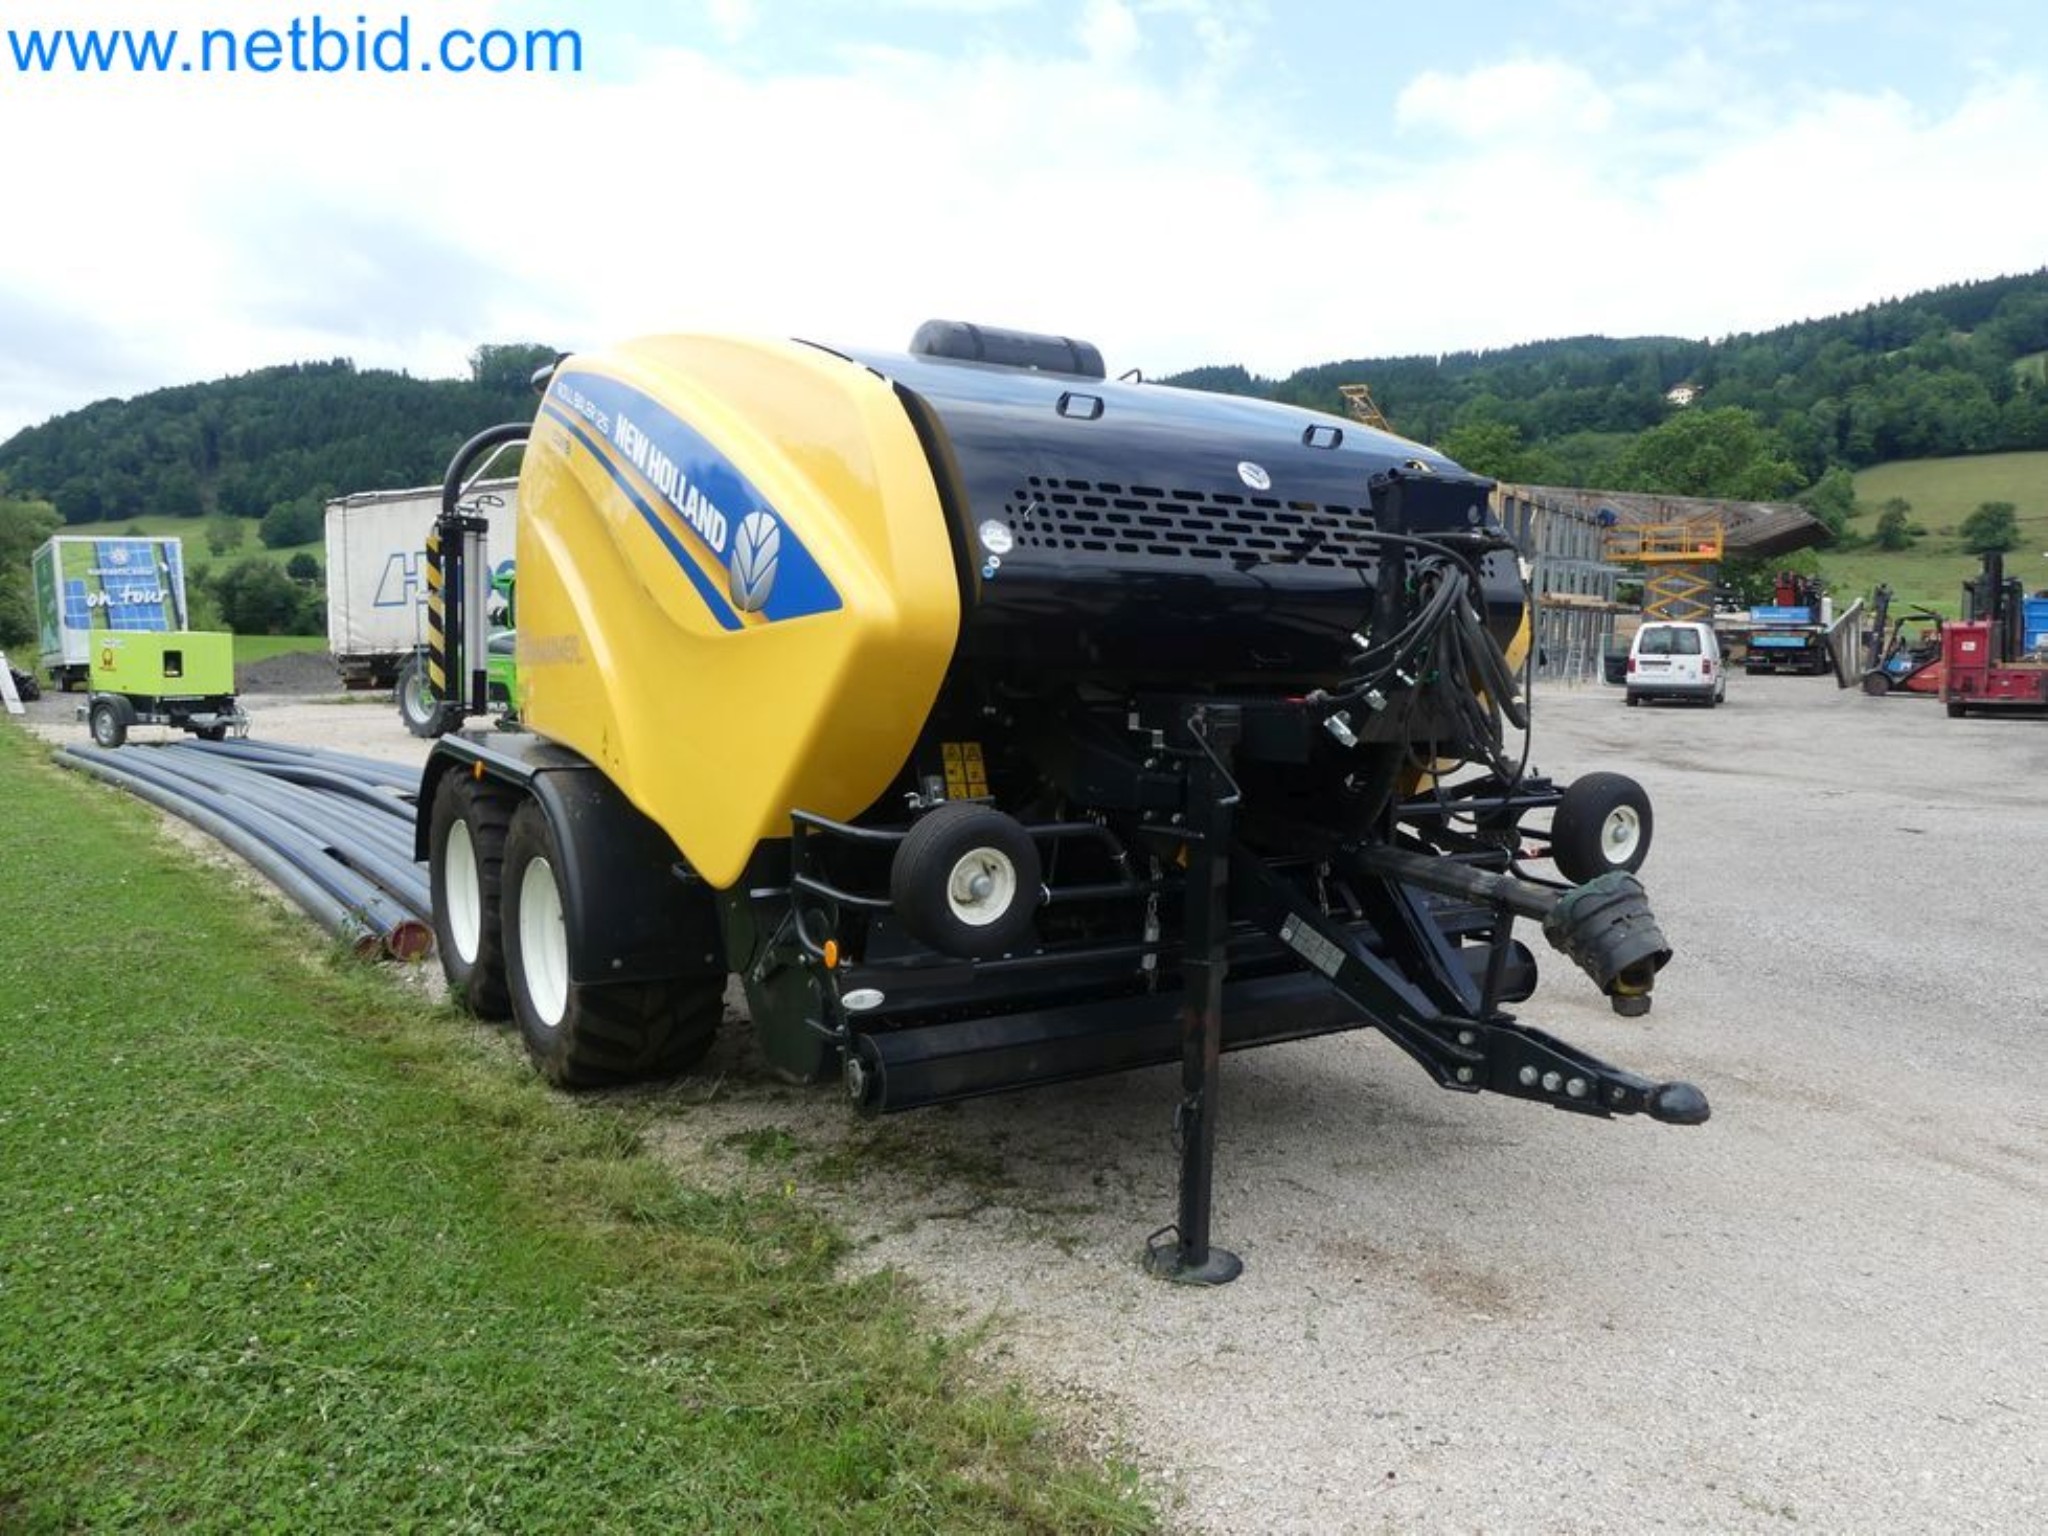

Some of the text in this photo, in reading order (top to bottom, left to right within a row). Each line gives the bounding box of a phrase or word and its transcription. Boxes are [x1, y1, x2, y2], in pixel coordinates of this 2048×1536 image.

[614, 411, 728, 553] NEW HOLLAND
[86, 584, 169, 608] on tour
